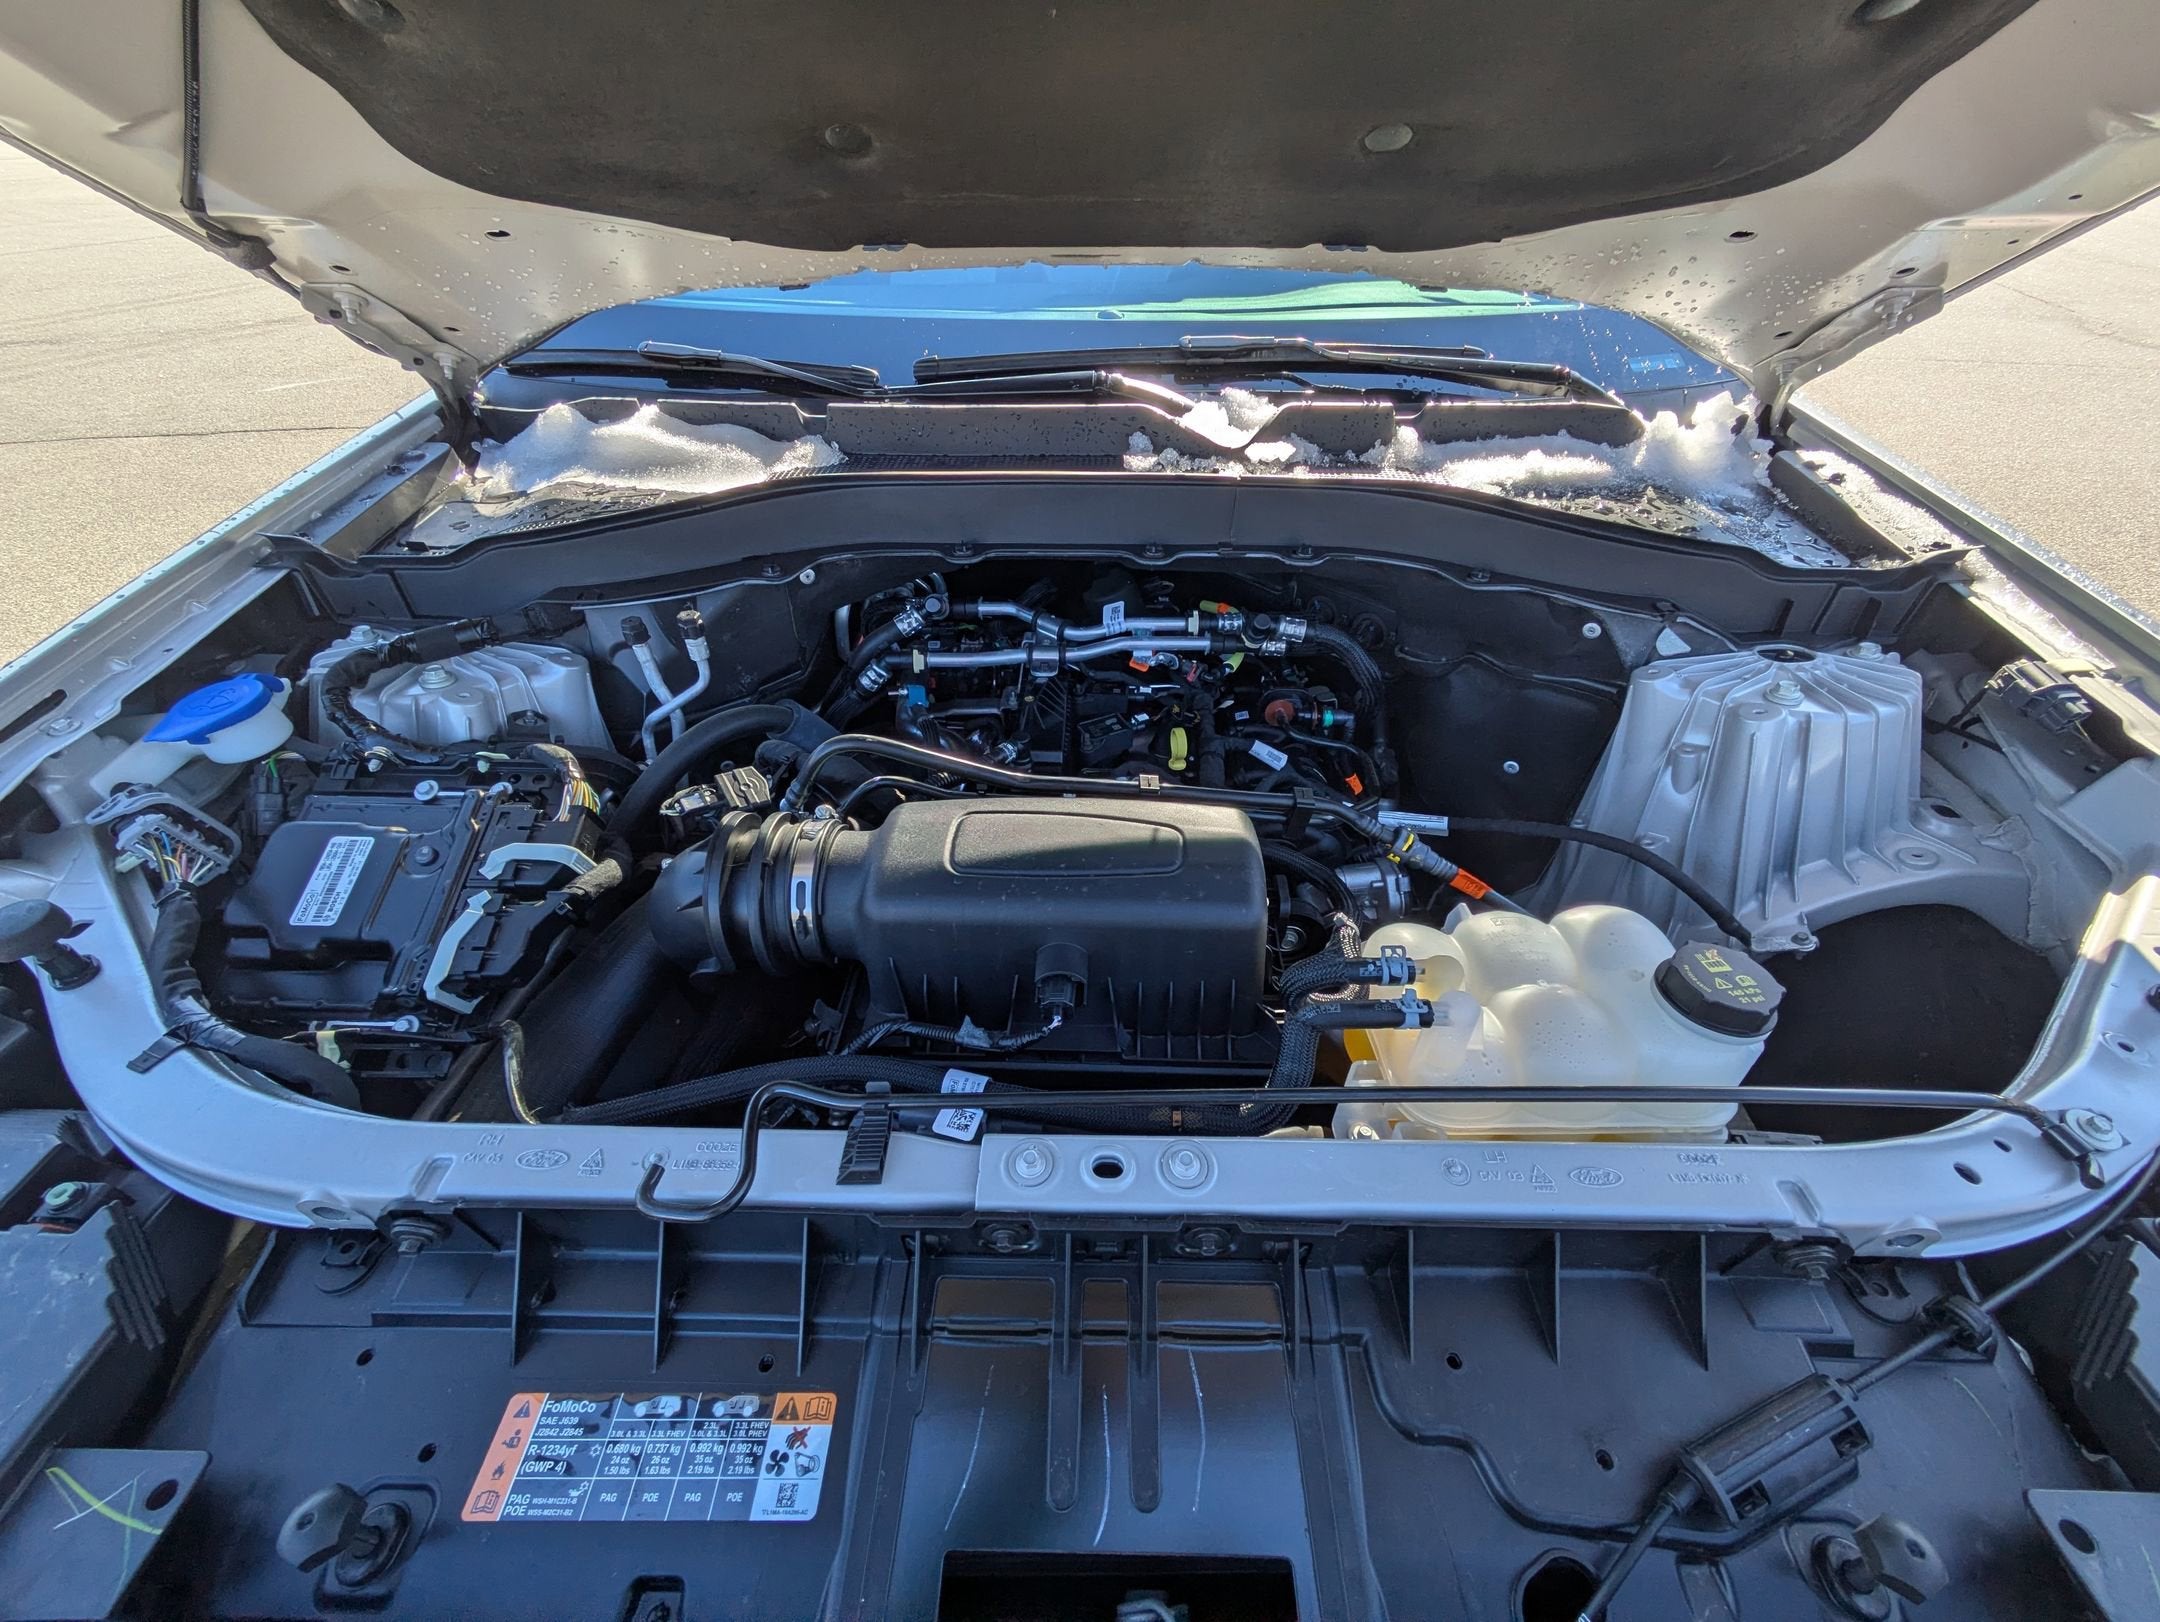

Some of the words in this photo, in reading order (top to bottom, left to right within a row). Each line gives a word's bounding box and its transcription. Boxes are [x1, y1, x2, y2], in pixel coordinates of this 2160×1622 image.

[298, 893, 316, 922] FoMoCo
[328, 891, 341, 913] BOSCH
[1483, 1151, 1507, 1163] LH
[543, 1400, 597, 1413] FoMoCo
[539, 1416, 557, 1425] SAE
[558, 1416, 579, 1425] J639
[704, 1422, 718, 1430] 2.3L
[535, 1428, 559, 1436] J2842
[559, 1428, 584, 1437] J2845
[666, 1430, 685, 1438] FHEV
[712, 1430, 727, 1438] 3.3L
[748, 1430, 768, 1438] PHEV
[527, 1444, 579, 1459] R-1234yf
[606, 1443, 629, 1454] 0.680
[630, 1443, 641, 1456] kg
[647, 1443, 669, 1454] 0.737
[670, 1443, 681, 1455] kg
[689, 1443, 712, 1453] 0.992
[713, 1443, 724, 1455] kg
[730, 1443, 752, 1453] 0.992
[753, 1443, 764, 1455] kg
[610, 1456, 619, 1464] 24
[694, 1455, 703, 1463] 35
[734, 1455, 743, 1463] 35
[520, 1461, 553, 1475] (GWP
[554, 1461, 567, 1475] 4)
[604, 1466, 618, 1474] 1.50
[619, 1466, 631, 1474] lbs
[644, 1466, 659, 1474] 1.63
[660, 1466, 671, 1474] lbs
[688, 1465, 703, 1474] 2.19
[704, 1465, 715, 1474] lbs
[728, 1466, 743, 1474] 2.19
[744, 1466, 755, 1474] lbs
[507, 1494, 530, 1504] PAG
[599, 1492, 618, 1503] PAG
[641, 1492, 659, 1503] POE
[684, 1492, 702, 1503] PAG
[726, 1492, 744, 1503] POE
[503, 1505, 527, 1516] POE
